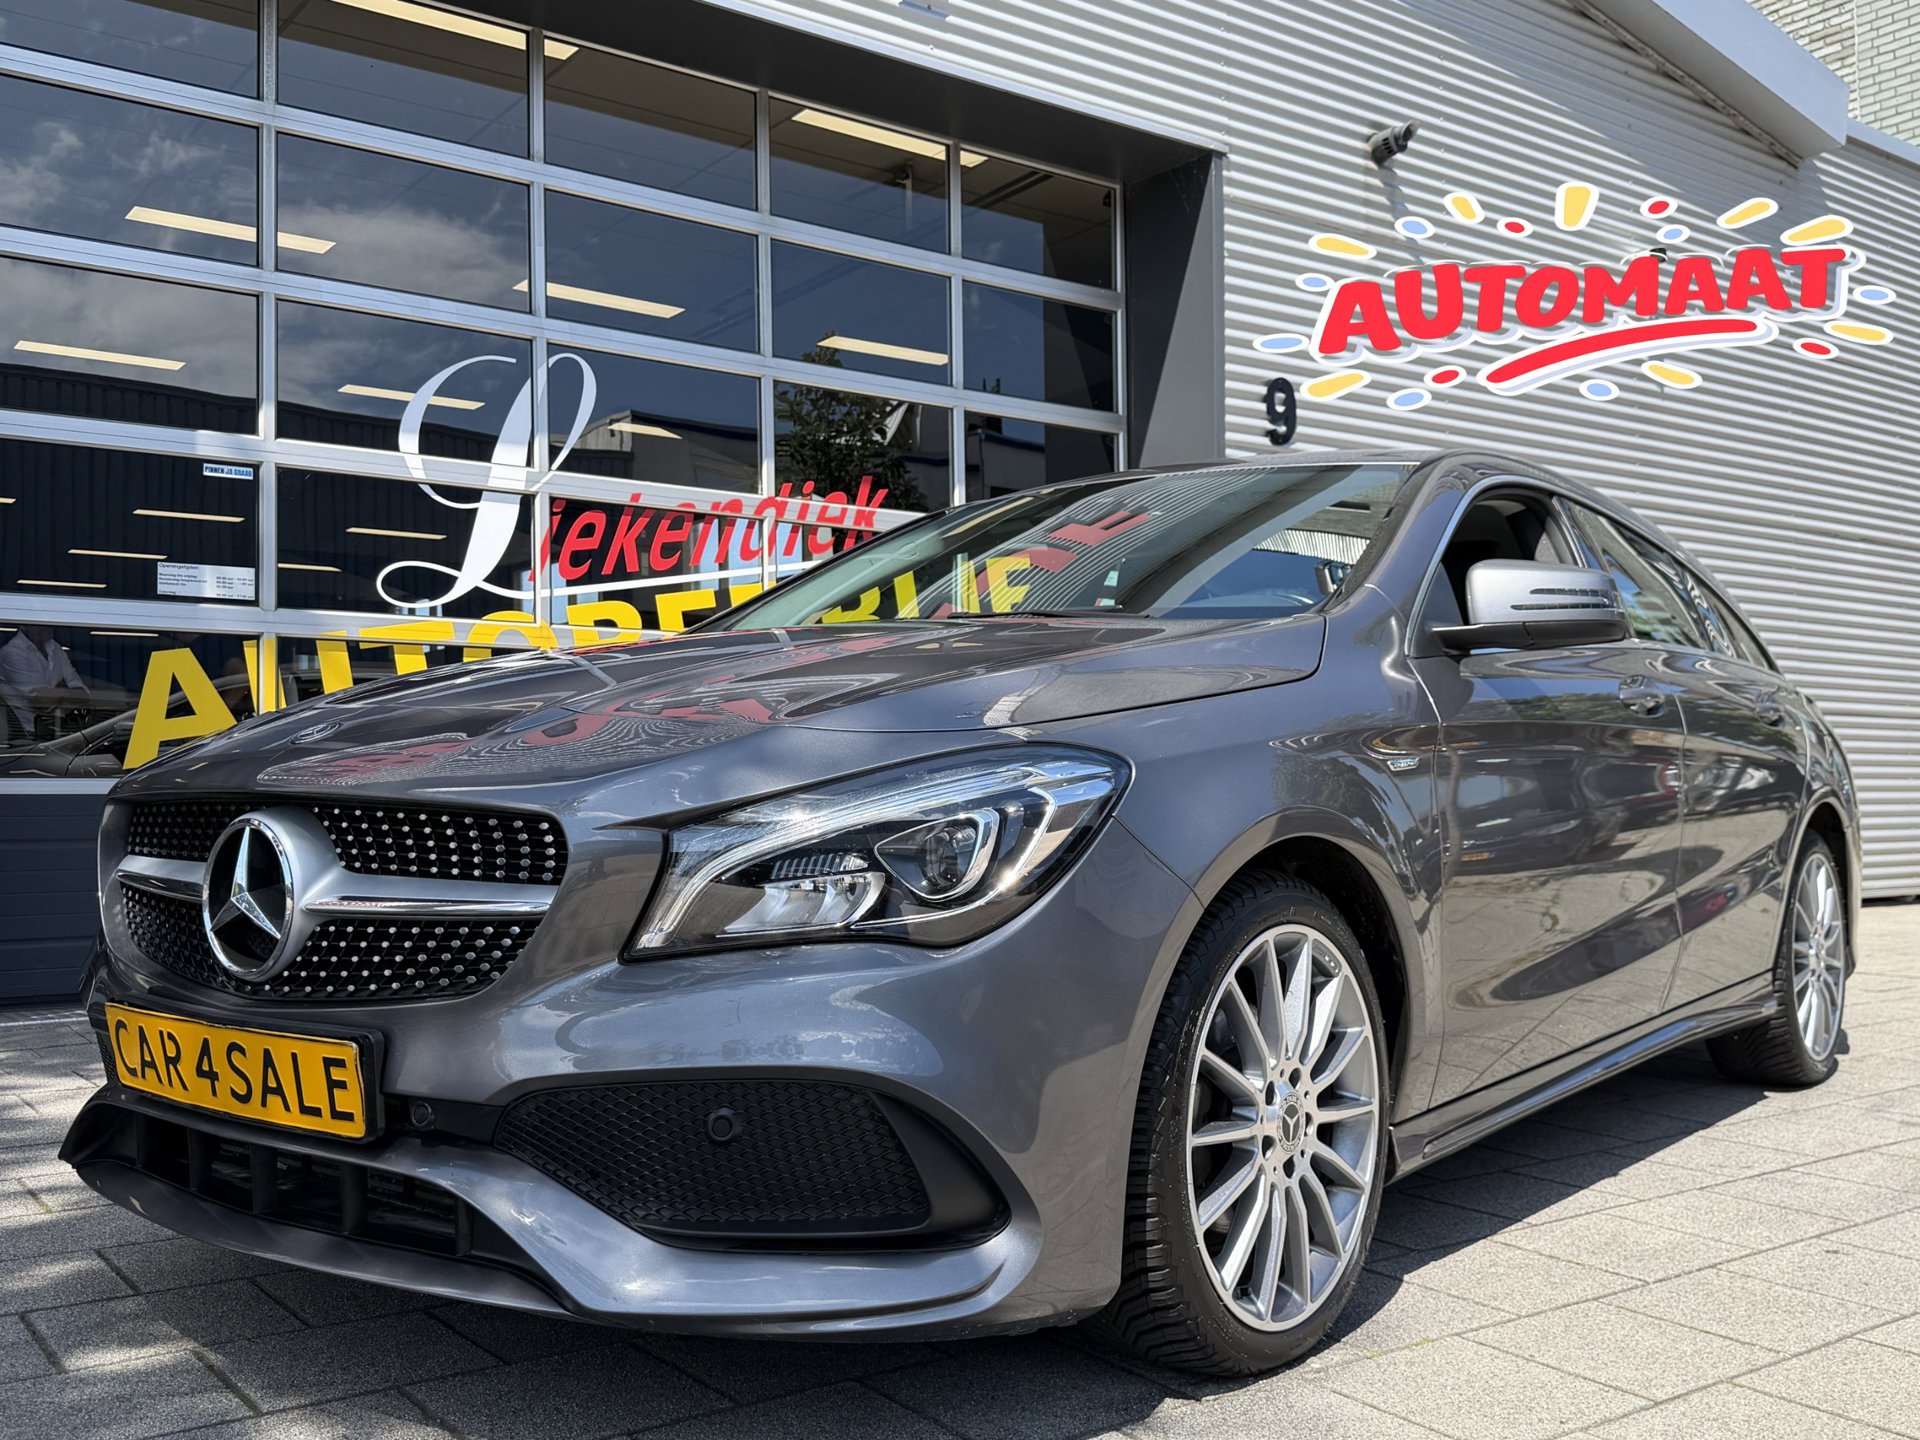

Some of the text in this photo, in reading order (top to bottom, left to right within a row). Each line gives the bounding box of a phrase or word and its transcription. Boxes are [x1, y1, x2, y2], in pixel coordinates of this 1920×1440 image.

[1266, 376, 1296, 446] 9
[114, 1018, 356, 1122] CAR 4 SALE
